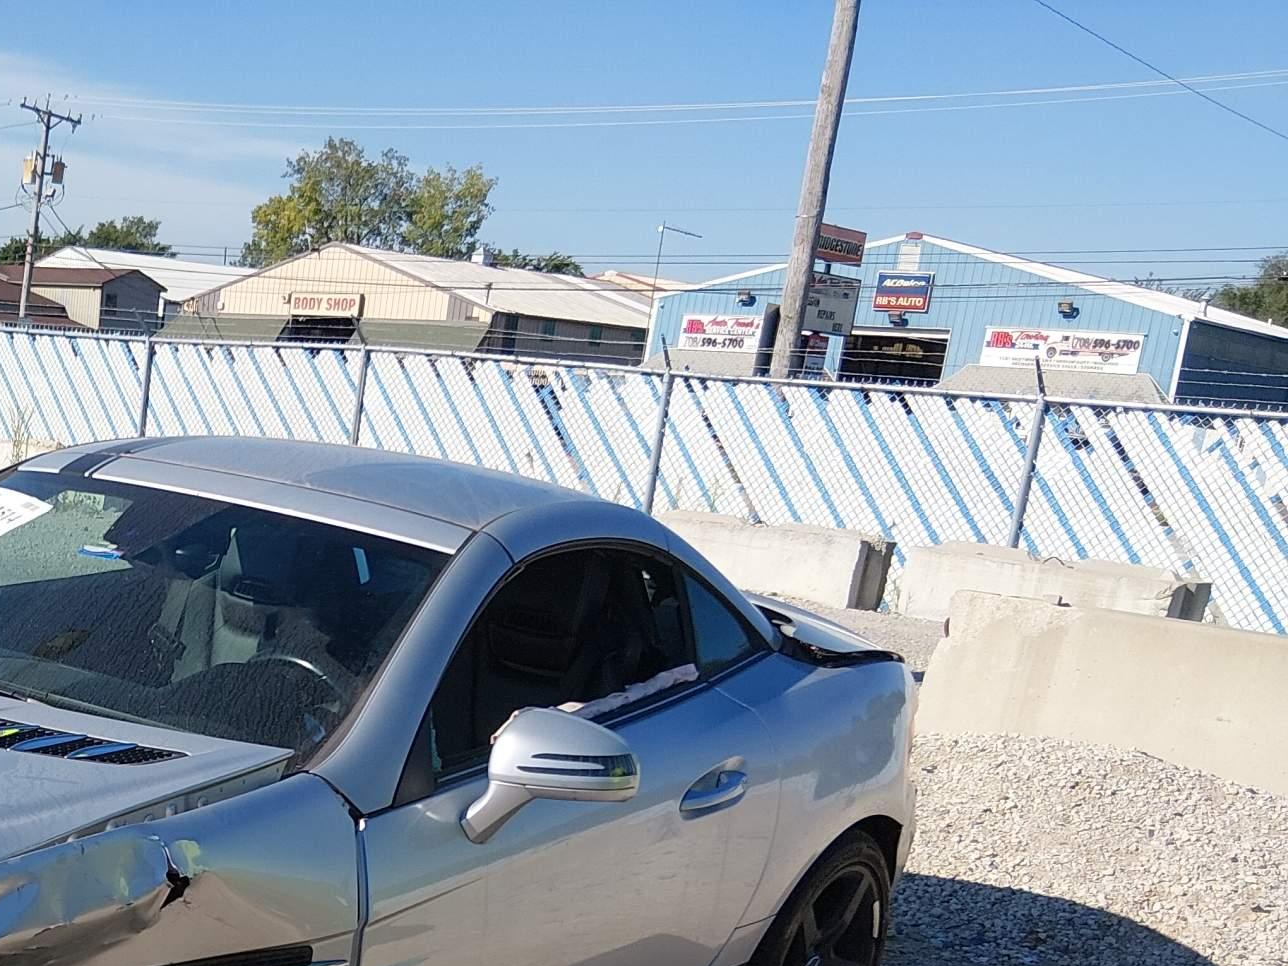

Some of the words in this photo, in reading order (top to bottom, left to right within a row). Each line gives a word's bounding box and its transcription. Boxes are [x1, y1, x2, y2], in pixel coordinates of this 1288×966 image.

[819, 235, 864, 257] RIDGESTONE
[293, 296, 323, 311] BODY
[325, 297, 356, 312] SHOP
[875, 296, 897, 306] RB'S
[896, 297, 924, 306] AUTO
